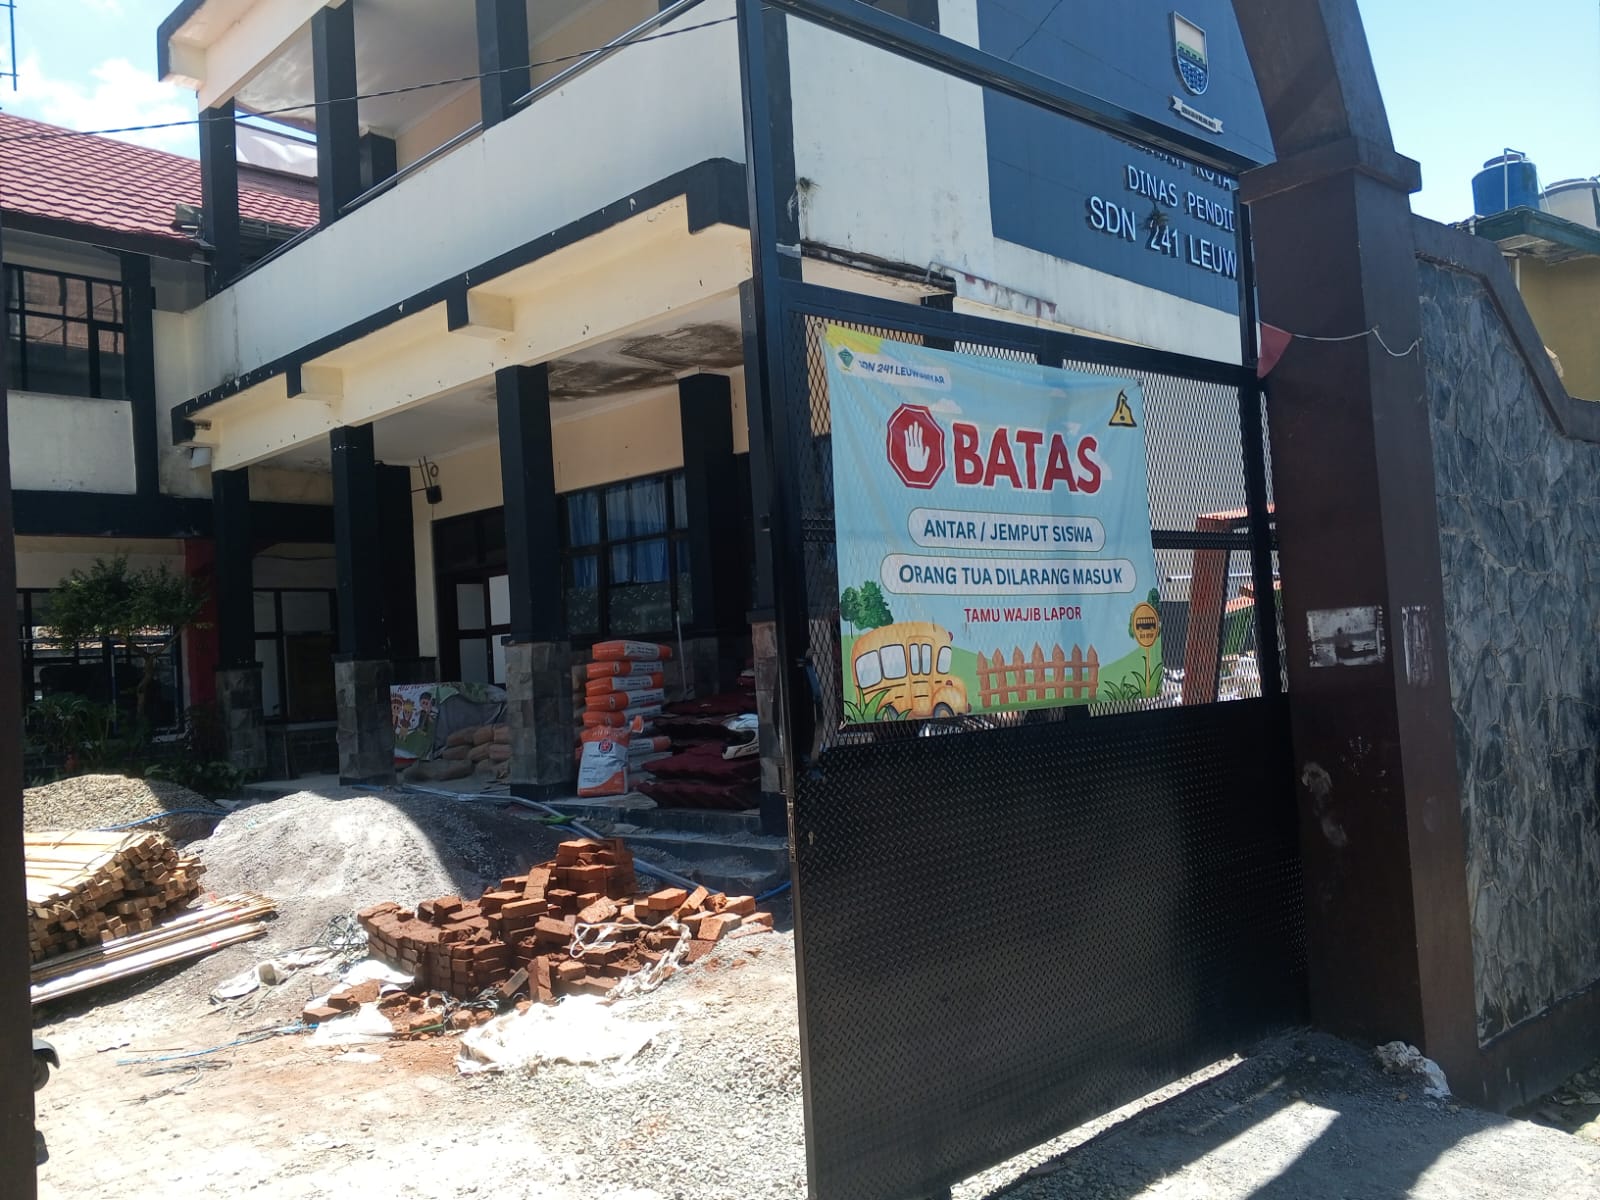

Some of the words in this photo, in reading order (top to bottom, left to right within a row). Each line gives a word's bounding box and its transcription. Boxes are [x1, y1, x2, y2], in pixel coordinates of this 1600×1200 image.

[1127, 165, 1178, 207] DINAS
[1090, 196, 1136, 241] SDN
[1149, 216, 1179, 257] 241
[876, 363, 894, 374] 241
[952, 422, 1102, 494] BATAS
[923, 519, 976, 540] ANTAR
[980, 521, 986, 542] /
[990, 522, 1049, 542] JEMPUT
[1052, 525, 1094, 543] SISWA
[899, 564, 957, 585] ORANG
[961, 567, 992, 585] TUA
[996, 567, 1070, 585] DILARANG
[1072, 567, 1123, 585] MASUK
[964, 607, 1000, 623] TAMU
[1003, 607, 1041, 622] WAJIB
[1043, 606, 1082, 621] LAPOR
